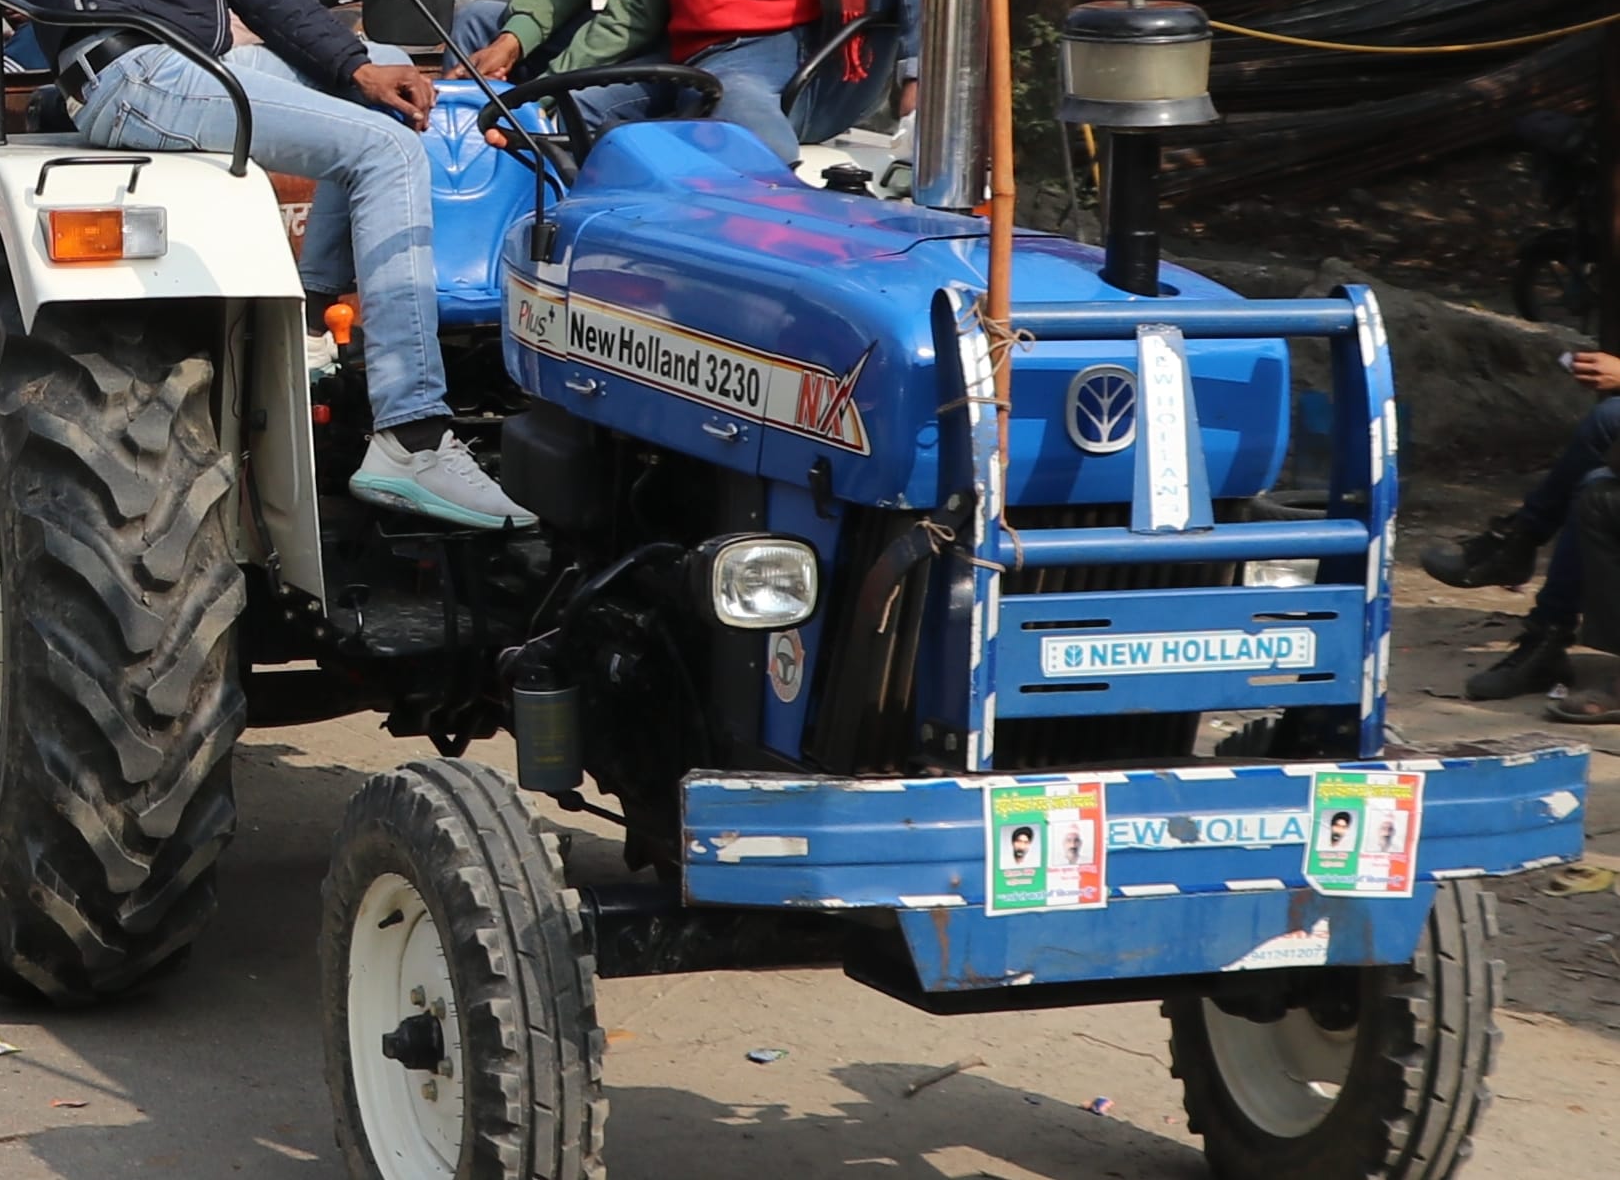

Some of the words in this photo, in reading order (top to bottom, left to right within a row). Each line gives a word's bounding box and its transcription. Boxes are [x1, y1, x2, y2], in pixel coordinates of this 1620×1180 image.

[570, 311, 616, 358] New
[619, 329, 699, 387] Holland
[705, 353, 760, 407] 3230
[1089, 641, 1156, 667] NEW
[1162, 636, 1293, 663] HOLLAND
[1109, 821, 1167, 846] EW
